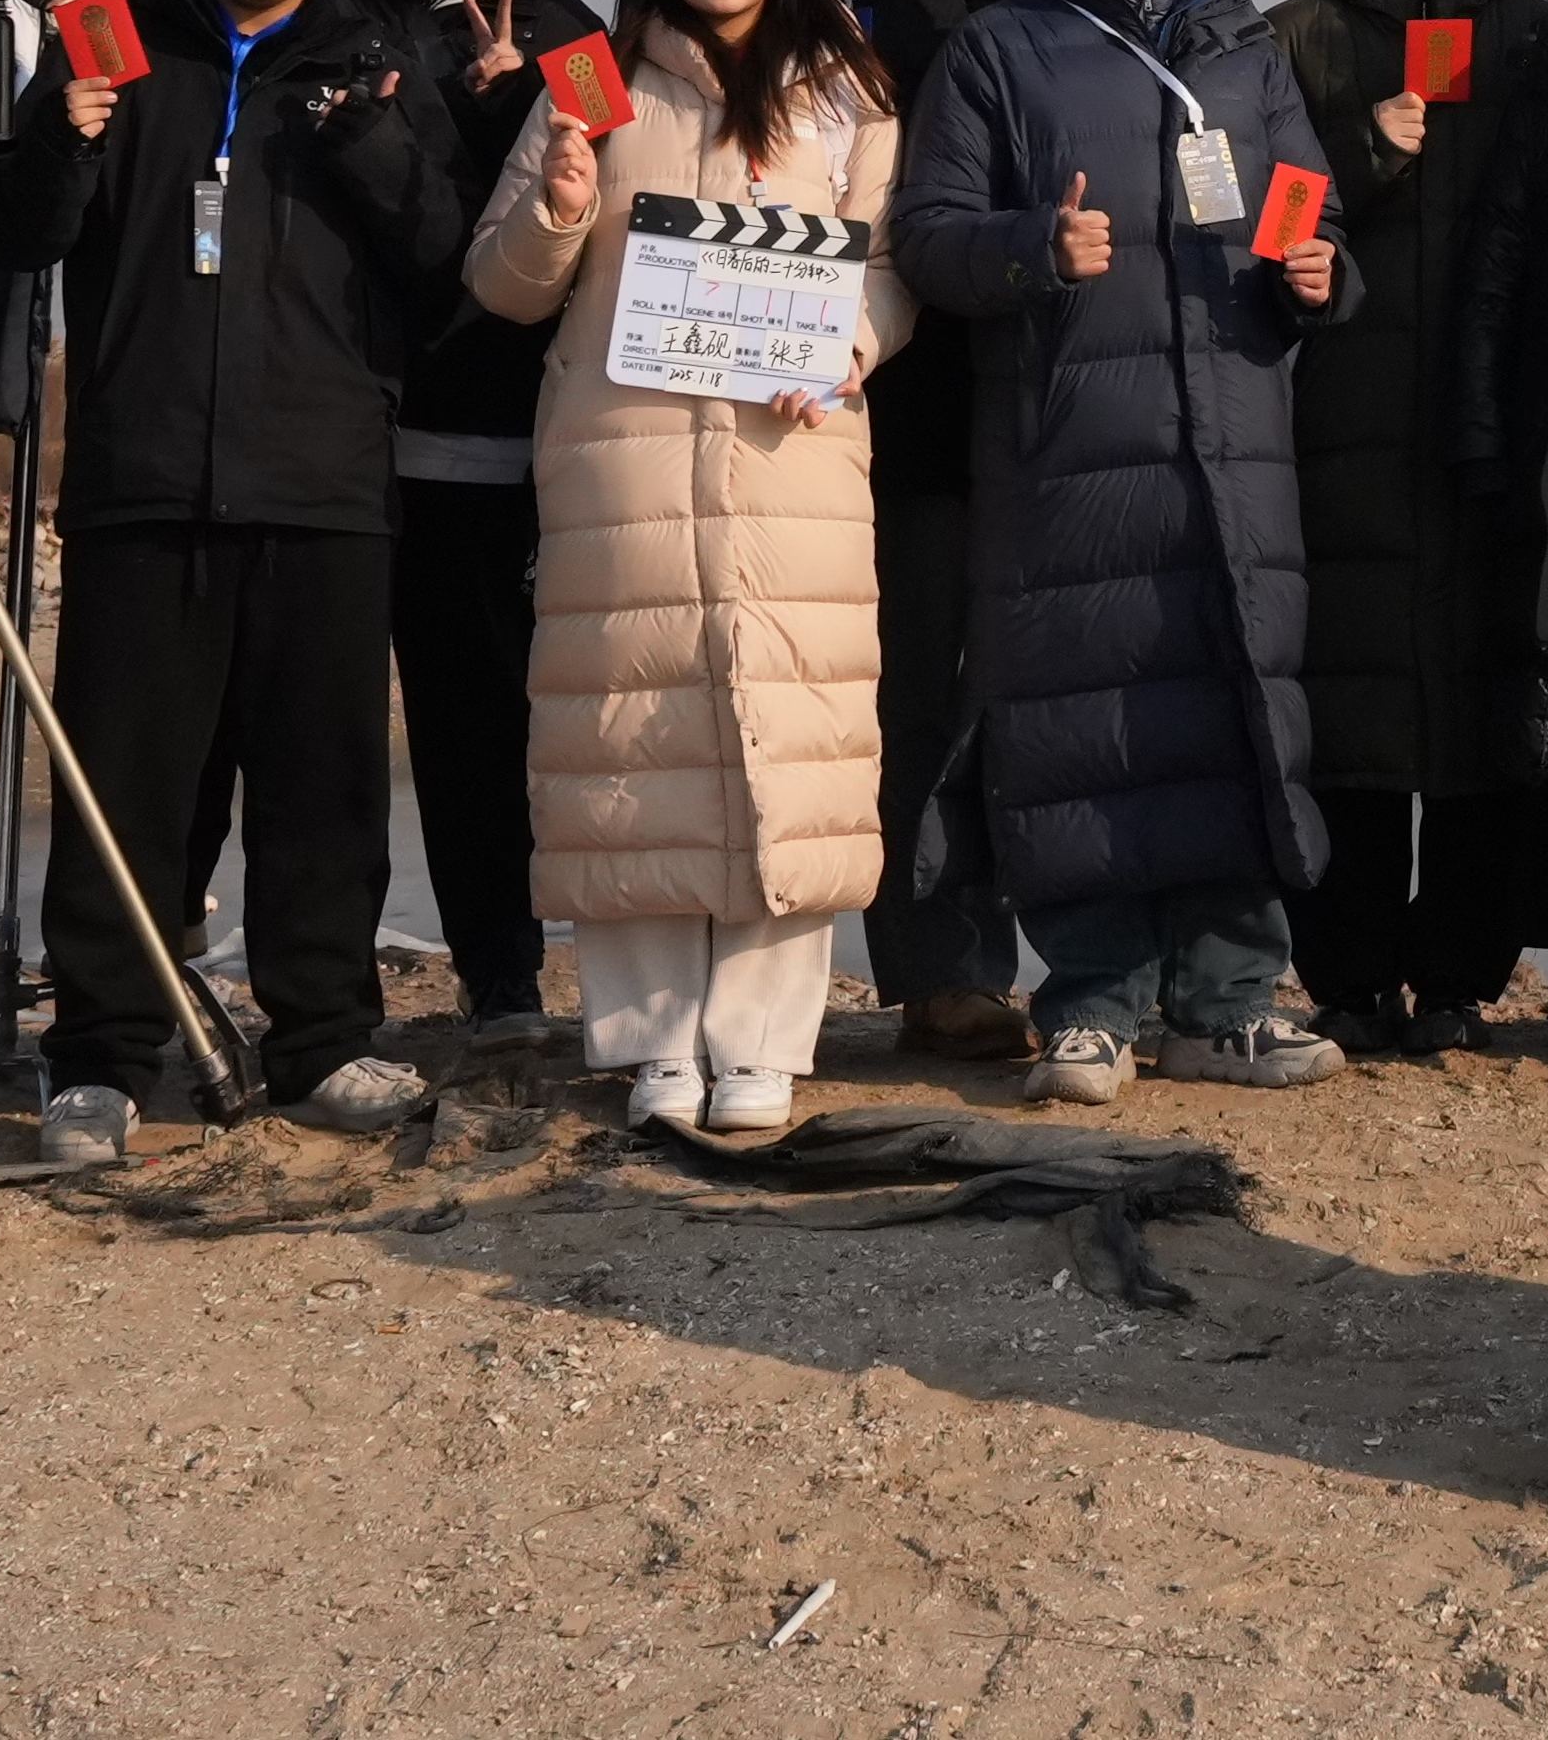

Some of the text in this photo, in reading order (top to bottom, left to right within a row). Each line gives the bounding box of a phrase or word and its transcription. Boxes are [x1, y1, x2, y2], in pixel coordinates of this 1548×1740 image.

[632, 299, 655, 310] ROLL
[685, 307, 715, 319] SCENE
[740, 313, 764, 324] SHOT
[795, 321, 818, 332] TAKE
